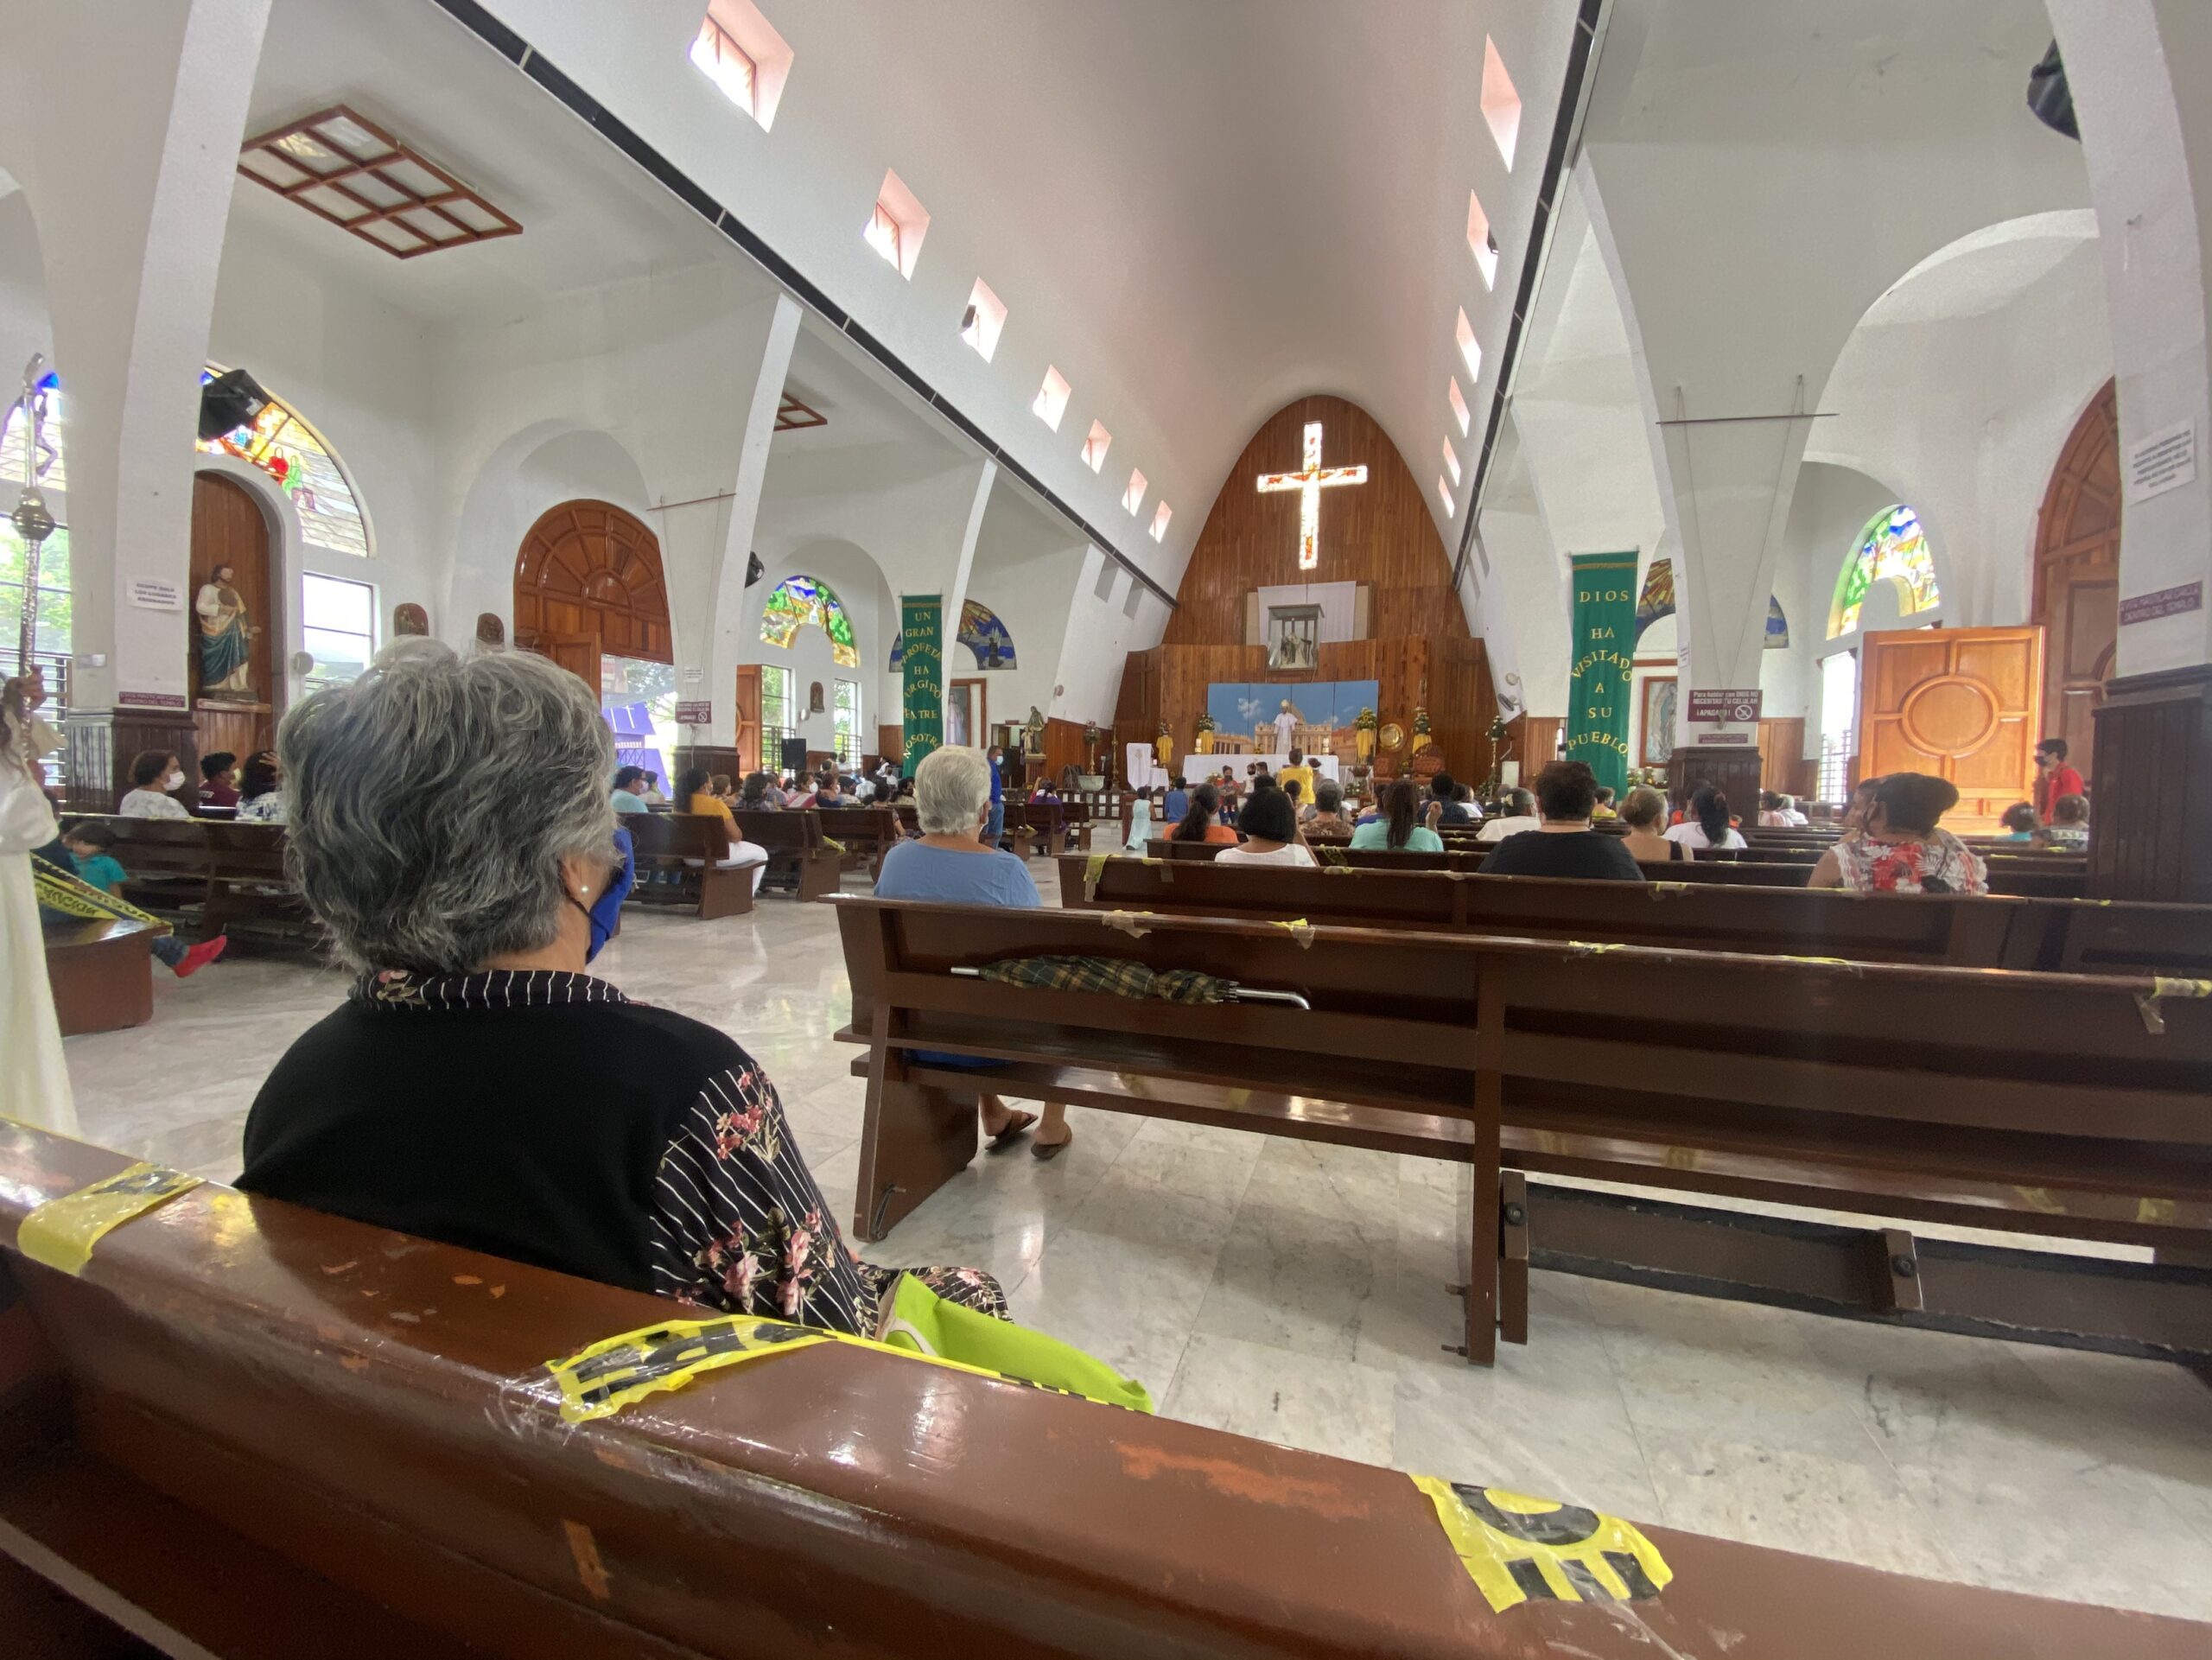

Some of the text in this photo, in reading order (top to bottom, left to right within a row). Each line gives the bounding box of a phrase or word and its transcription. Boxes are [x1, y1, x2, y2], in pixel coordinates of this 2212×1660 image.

[1580, 590, 1629, 602] DIOS
[914, 611, 931, 621] UN
[905, 626, 934, 638] GRAN
[1591, 626, 1615, 639] HA
[901, 642, 941, 665] PROFETA
[913, 665, 930, 676] HA
[1571, 650, 1633, 682] VISITADO
[904, 678, 942, 699] URGIDO
[1594, 682, 1605, 694] A
[1588, 707, 1612, 719] SU
